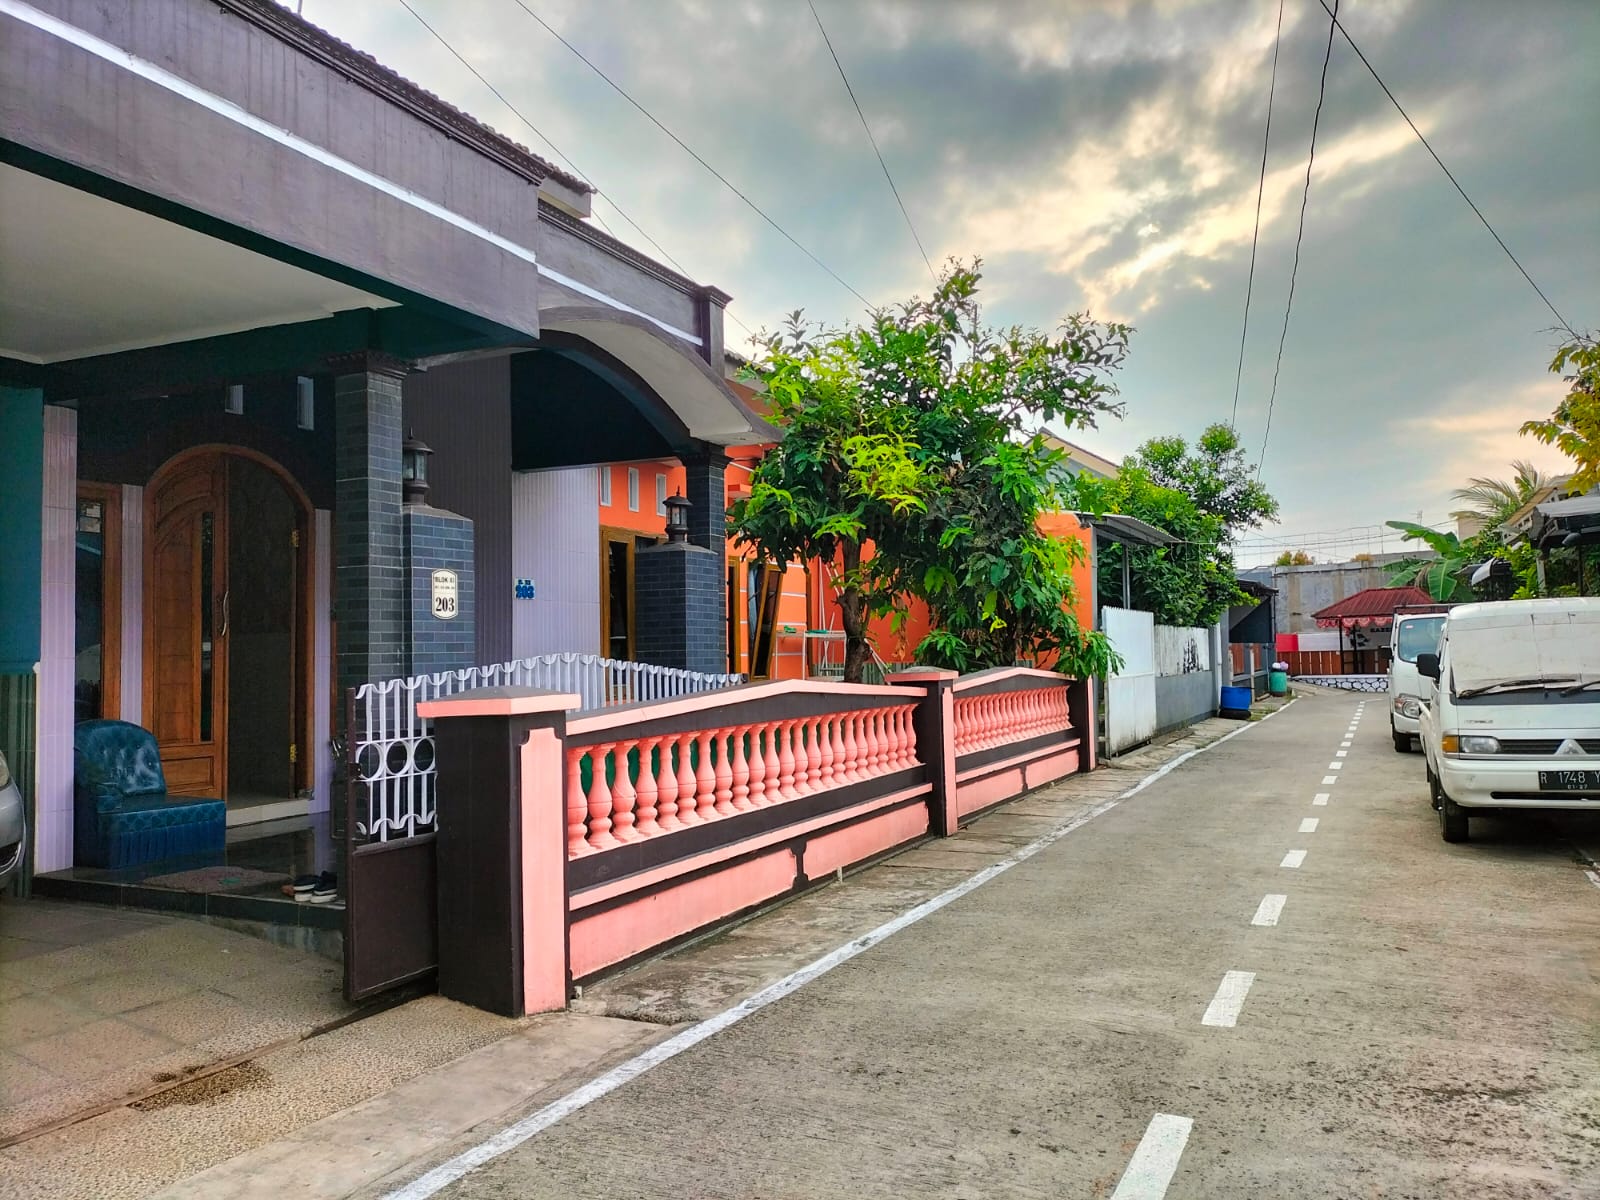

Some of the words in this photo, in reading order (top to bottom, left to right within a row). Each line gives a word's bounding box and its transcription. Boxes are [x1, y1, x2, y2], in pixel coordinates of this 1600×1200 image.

[435, 597, 455, 612] 203
[1540, 772, 1548, 784] R
[1558, 771, 1586, 784] 1748
